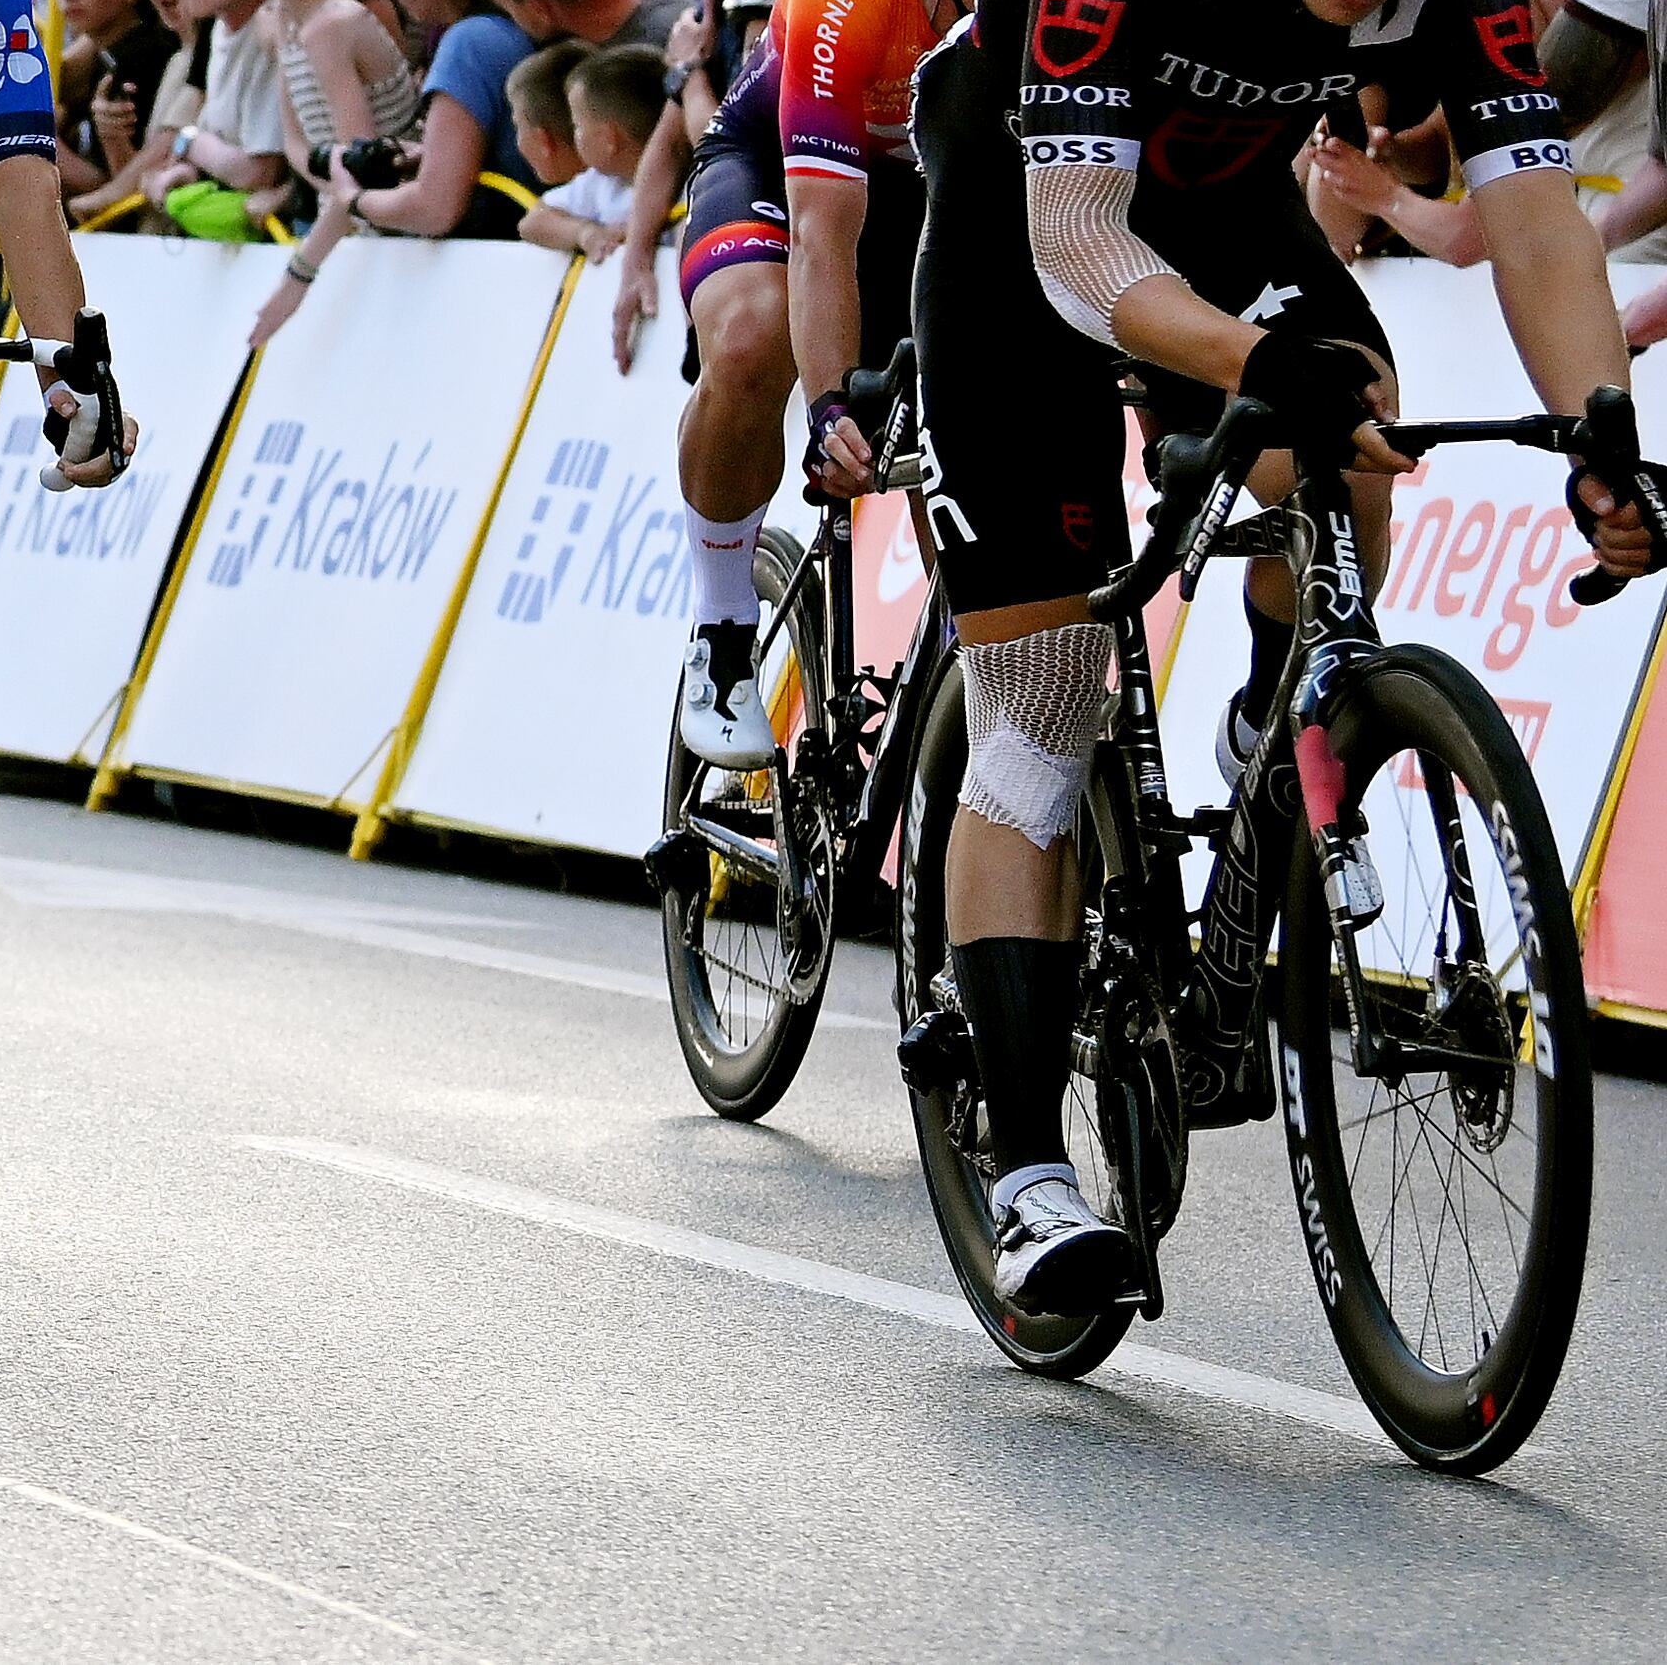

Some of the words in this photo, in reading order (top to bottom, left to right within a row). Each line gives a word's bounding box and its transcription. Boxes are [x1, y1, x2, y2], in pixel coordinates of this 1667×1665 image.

[1020, 85, 1131, 108] UDOR
[1154, 53, 1356, 107] TUDOR
[792, 135, 860, 157] PACTIMO
[878, 402, 909, 475] SRAM
[274, 437, 458, 583] Kraków
[1184, 483, 1234, 575] SRAM
[1328, 511, 1363, 598] BMC
[1296, 1154, 1343, 1306] SWISS
